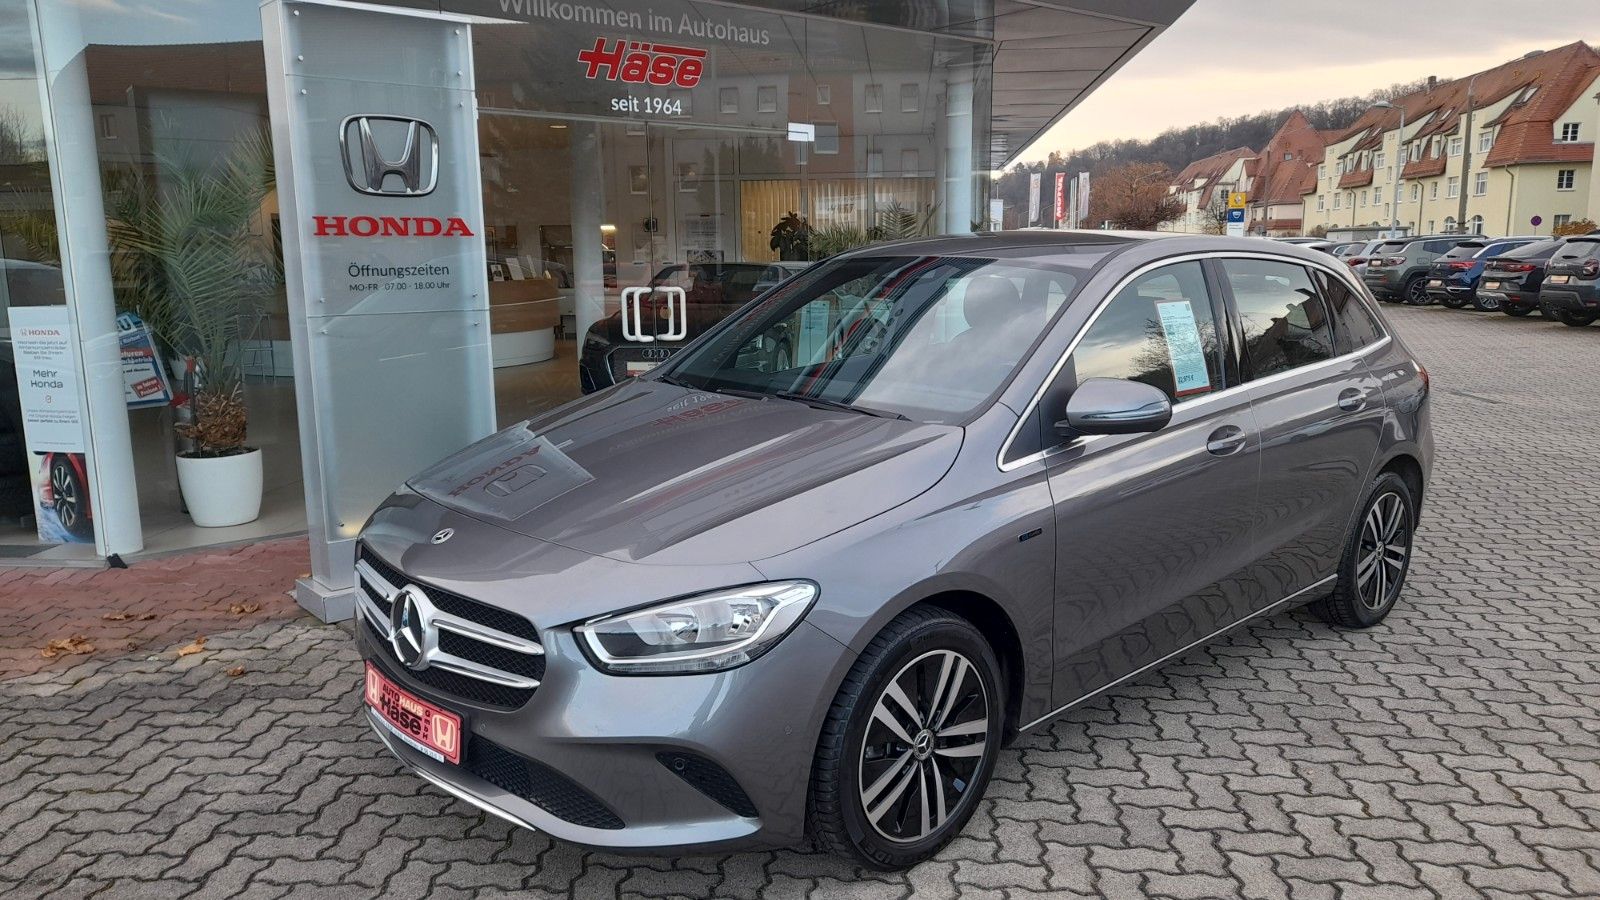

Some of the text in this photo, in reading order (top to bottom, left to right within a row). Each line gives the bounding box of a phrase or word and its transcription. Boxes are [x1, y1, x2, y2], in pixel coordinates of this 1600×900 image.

[500, 0, 770, 45] Willkommen im Autohaus
[577, 37, 708, 88] Häse
[611, 95, 682, 115] seit 1964
[312, 215, 474, 237] HONDA
[348, 262, 450, 279] Öffnungszeiten
[349, 283, 379, 292] MO-FR
[414, 282, 435, 290] 18.00
[436, 281, 450, 290] Uhr
[33, 369, 58, 378] Mehr
[30, 380, 64, 389] Honda
